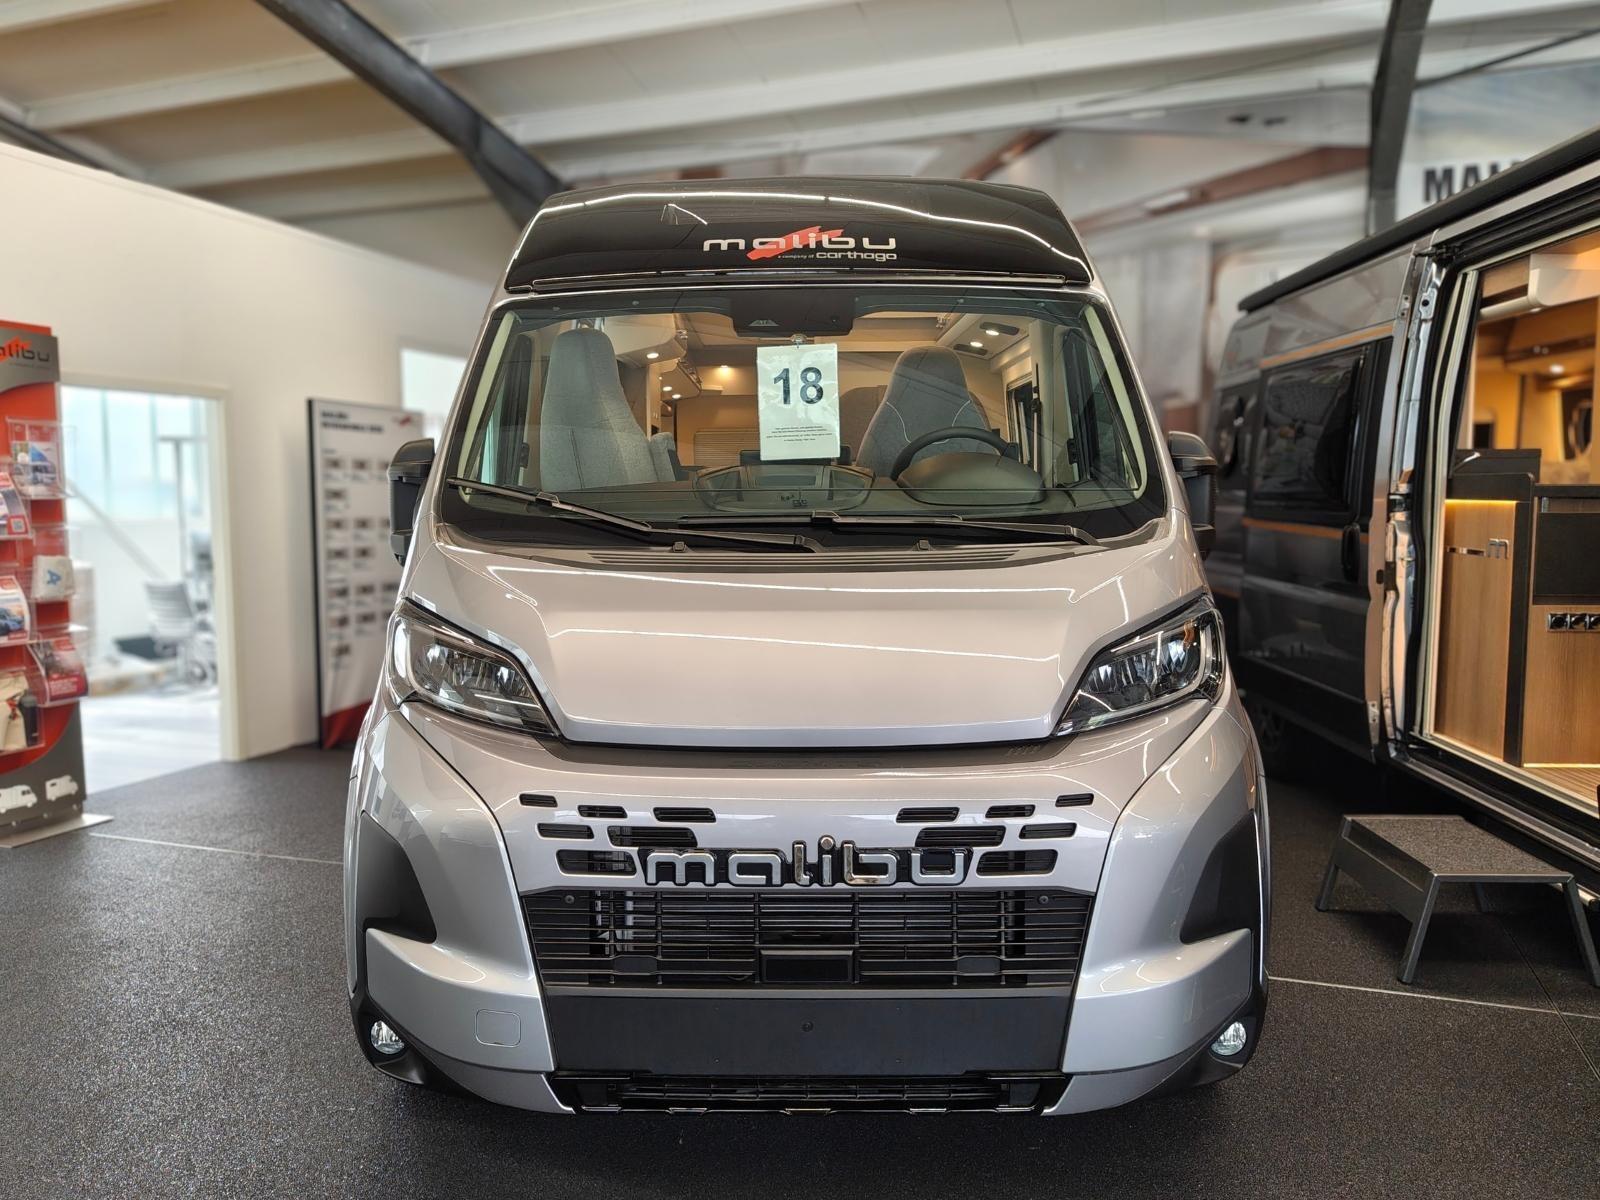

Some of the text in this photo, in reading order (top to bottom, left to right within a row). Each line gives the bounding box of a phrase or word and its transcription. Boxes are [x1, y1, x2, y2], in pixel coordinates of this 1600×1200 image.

[702, 233, 897, 251] malibu
[815, 250, 898, 262] carthago
[773, 366, 824, 405] 18
[645, 835, 967, 886] malibu
